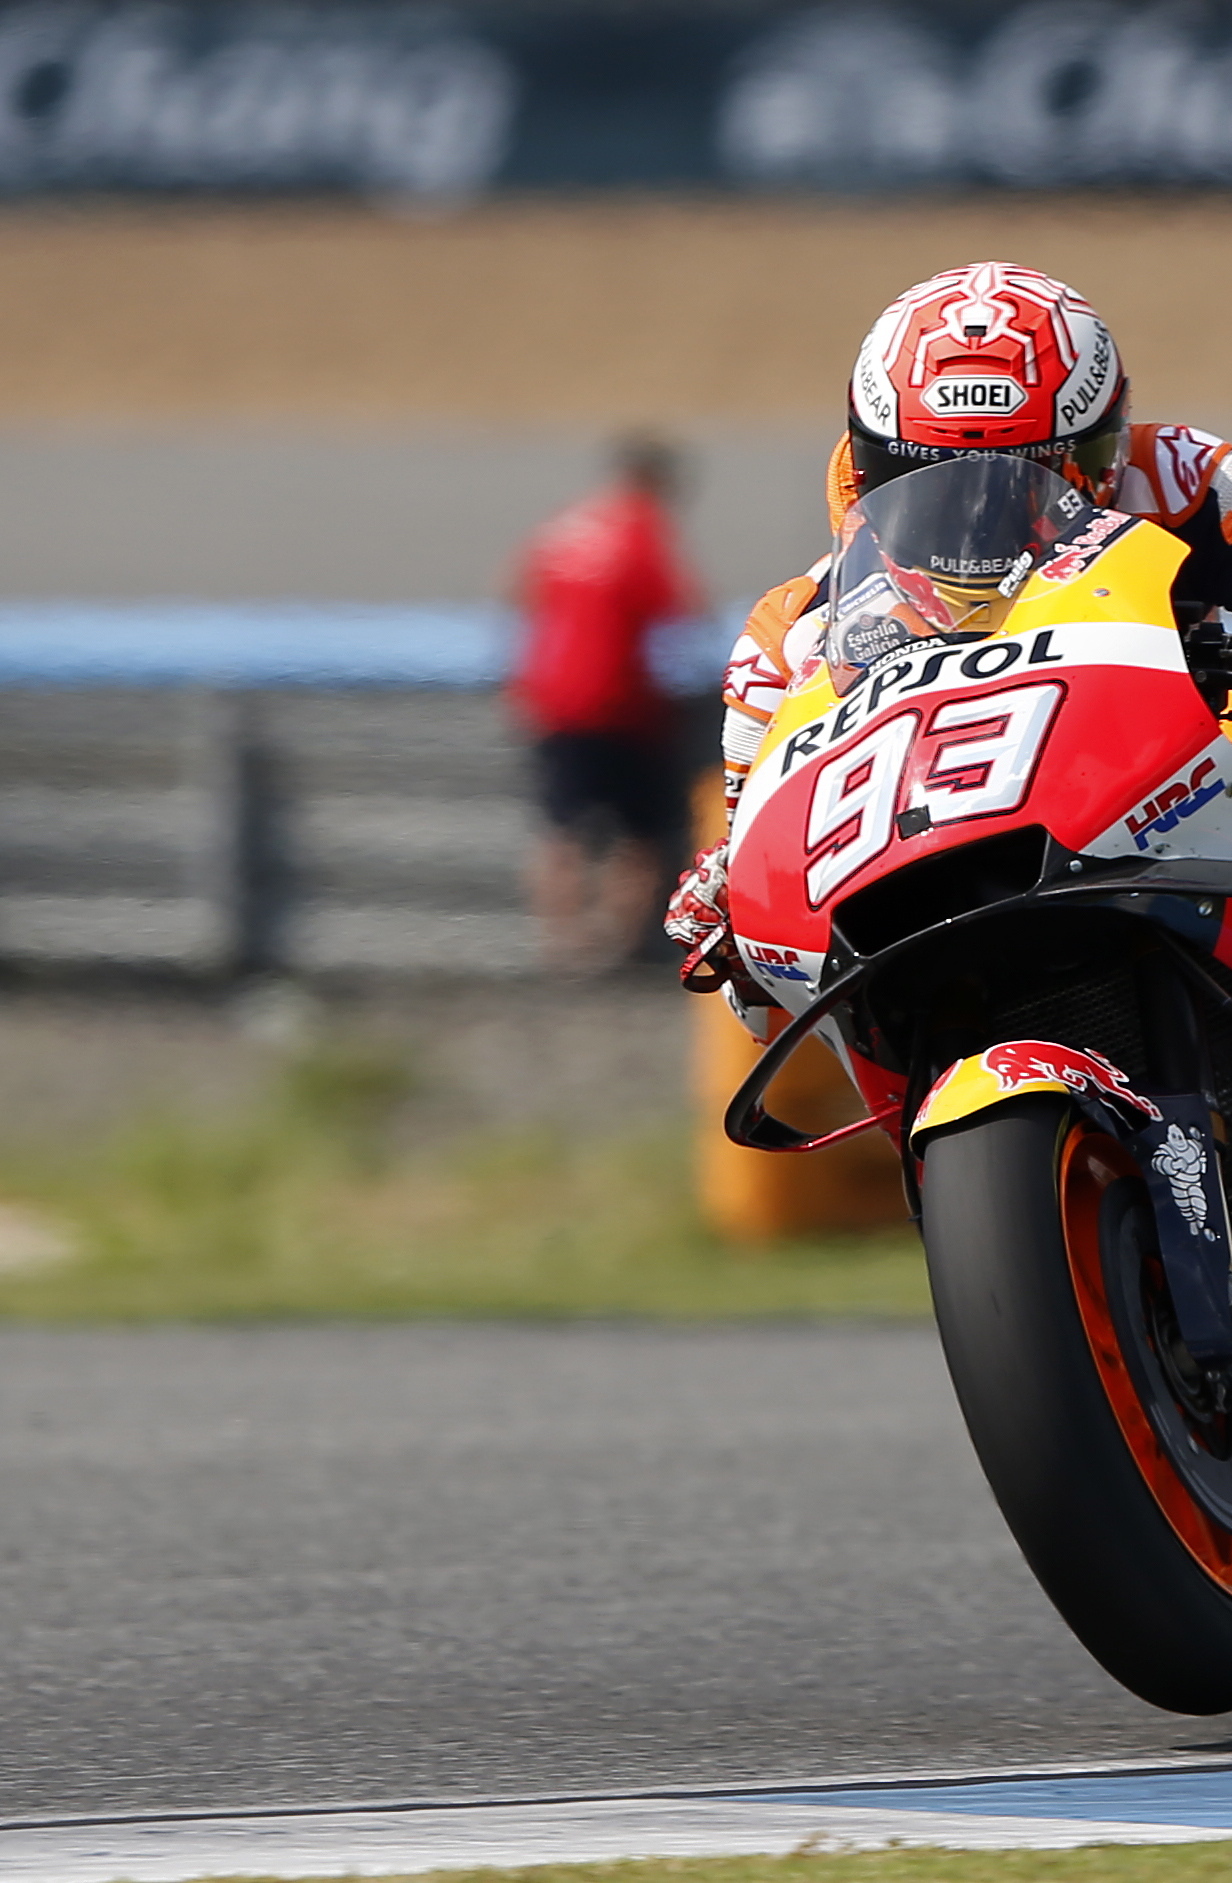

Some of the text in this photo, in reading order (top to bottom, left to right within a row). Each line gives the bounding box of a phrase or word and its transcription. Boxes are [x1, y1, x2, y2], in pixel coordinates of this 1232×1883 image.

[937, 383, 1012, 409] SHOEI
[887, 439, 1077, 464] GIVES YOU WINGS
[1057, 488, 1084, 520] 93
[997, 550, 1034, 599] Puig
[846, 621, 899, 648] Estrella
[867, 636, 947, 676] HONDA
[784, 629, 1064, 778] REPSOL
[805, 679, 1068, 911] 93
[1124, 755, 1227, 851] HRC
